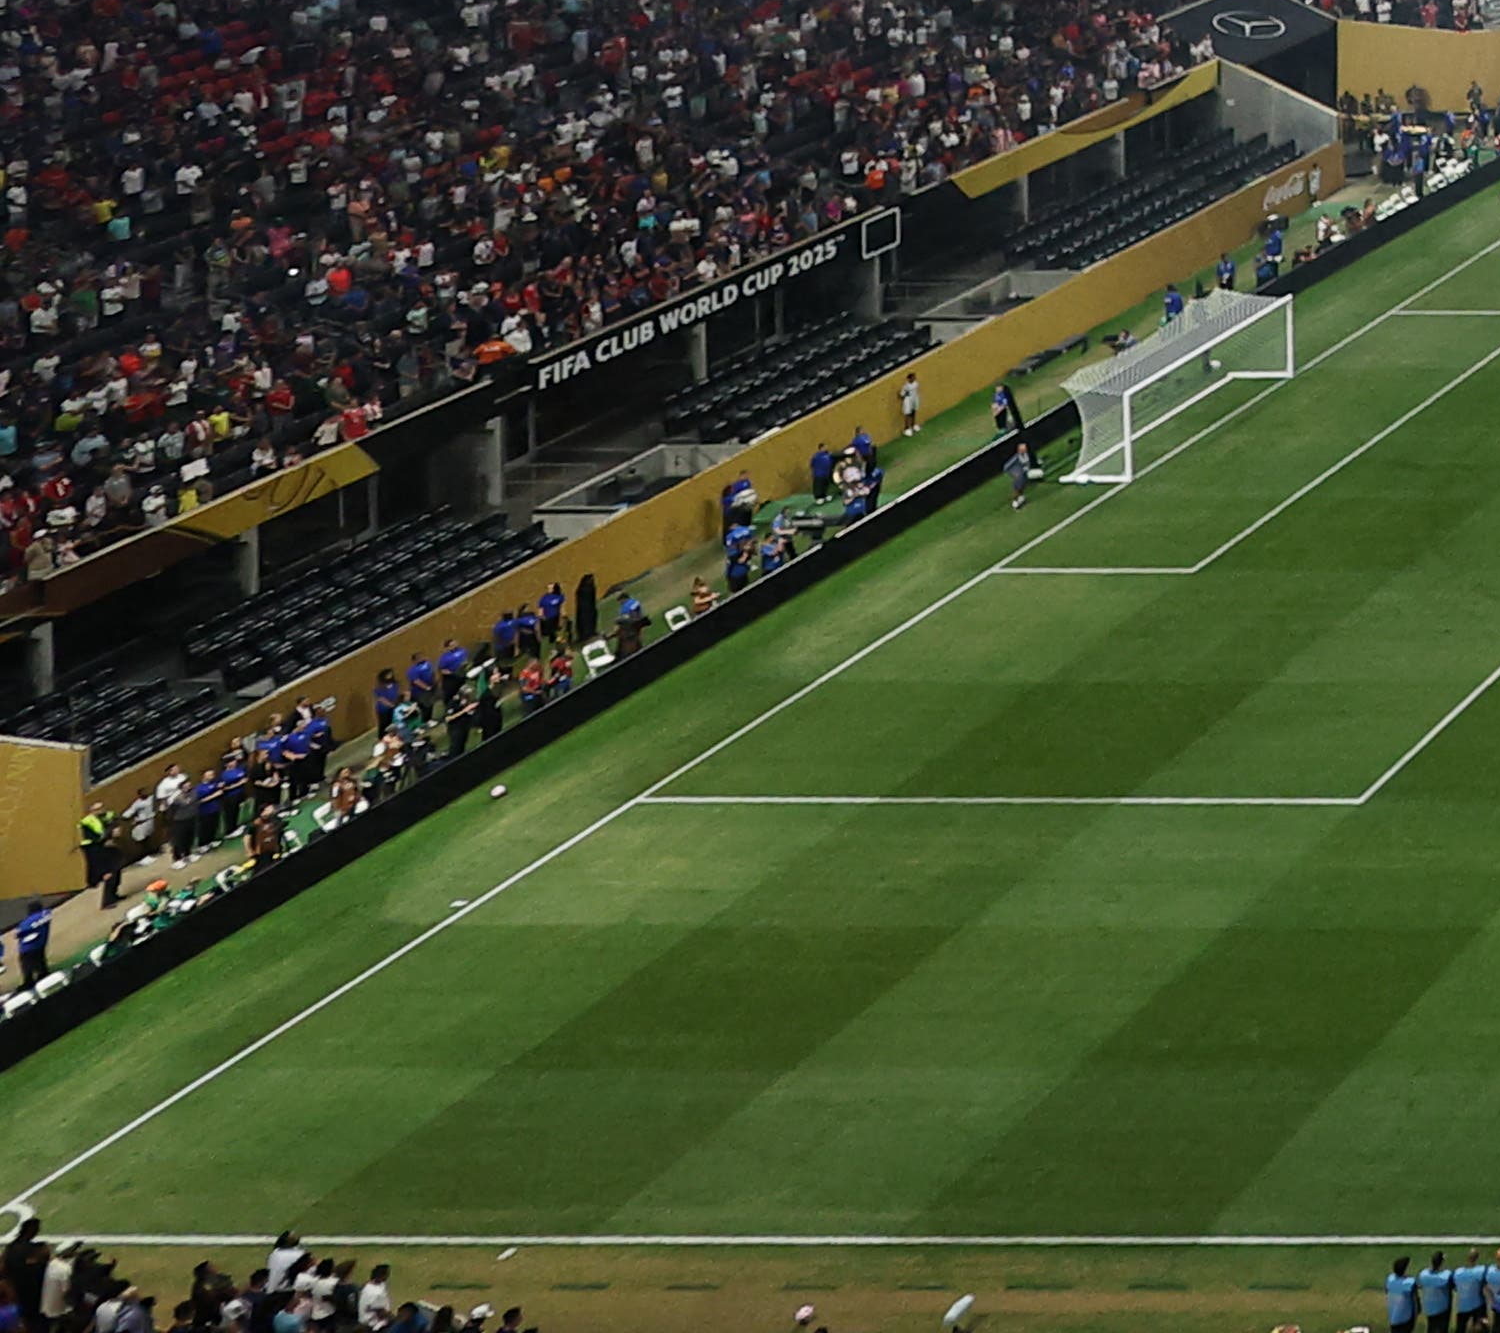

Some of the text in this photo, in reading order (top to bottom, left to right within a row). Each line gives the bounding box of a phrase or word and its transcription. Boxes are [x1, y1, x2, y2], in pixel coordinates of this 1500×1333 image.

[538, 349, 592, 390] FIFA
[595, 316, 655, 363] CLUB
[657, 282, 739, 336] WORLD
[742, 263, 784, 296] CUP
